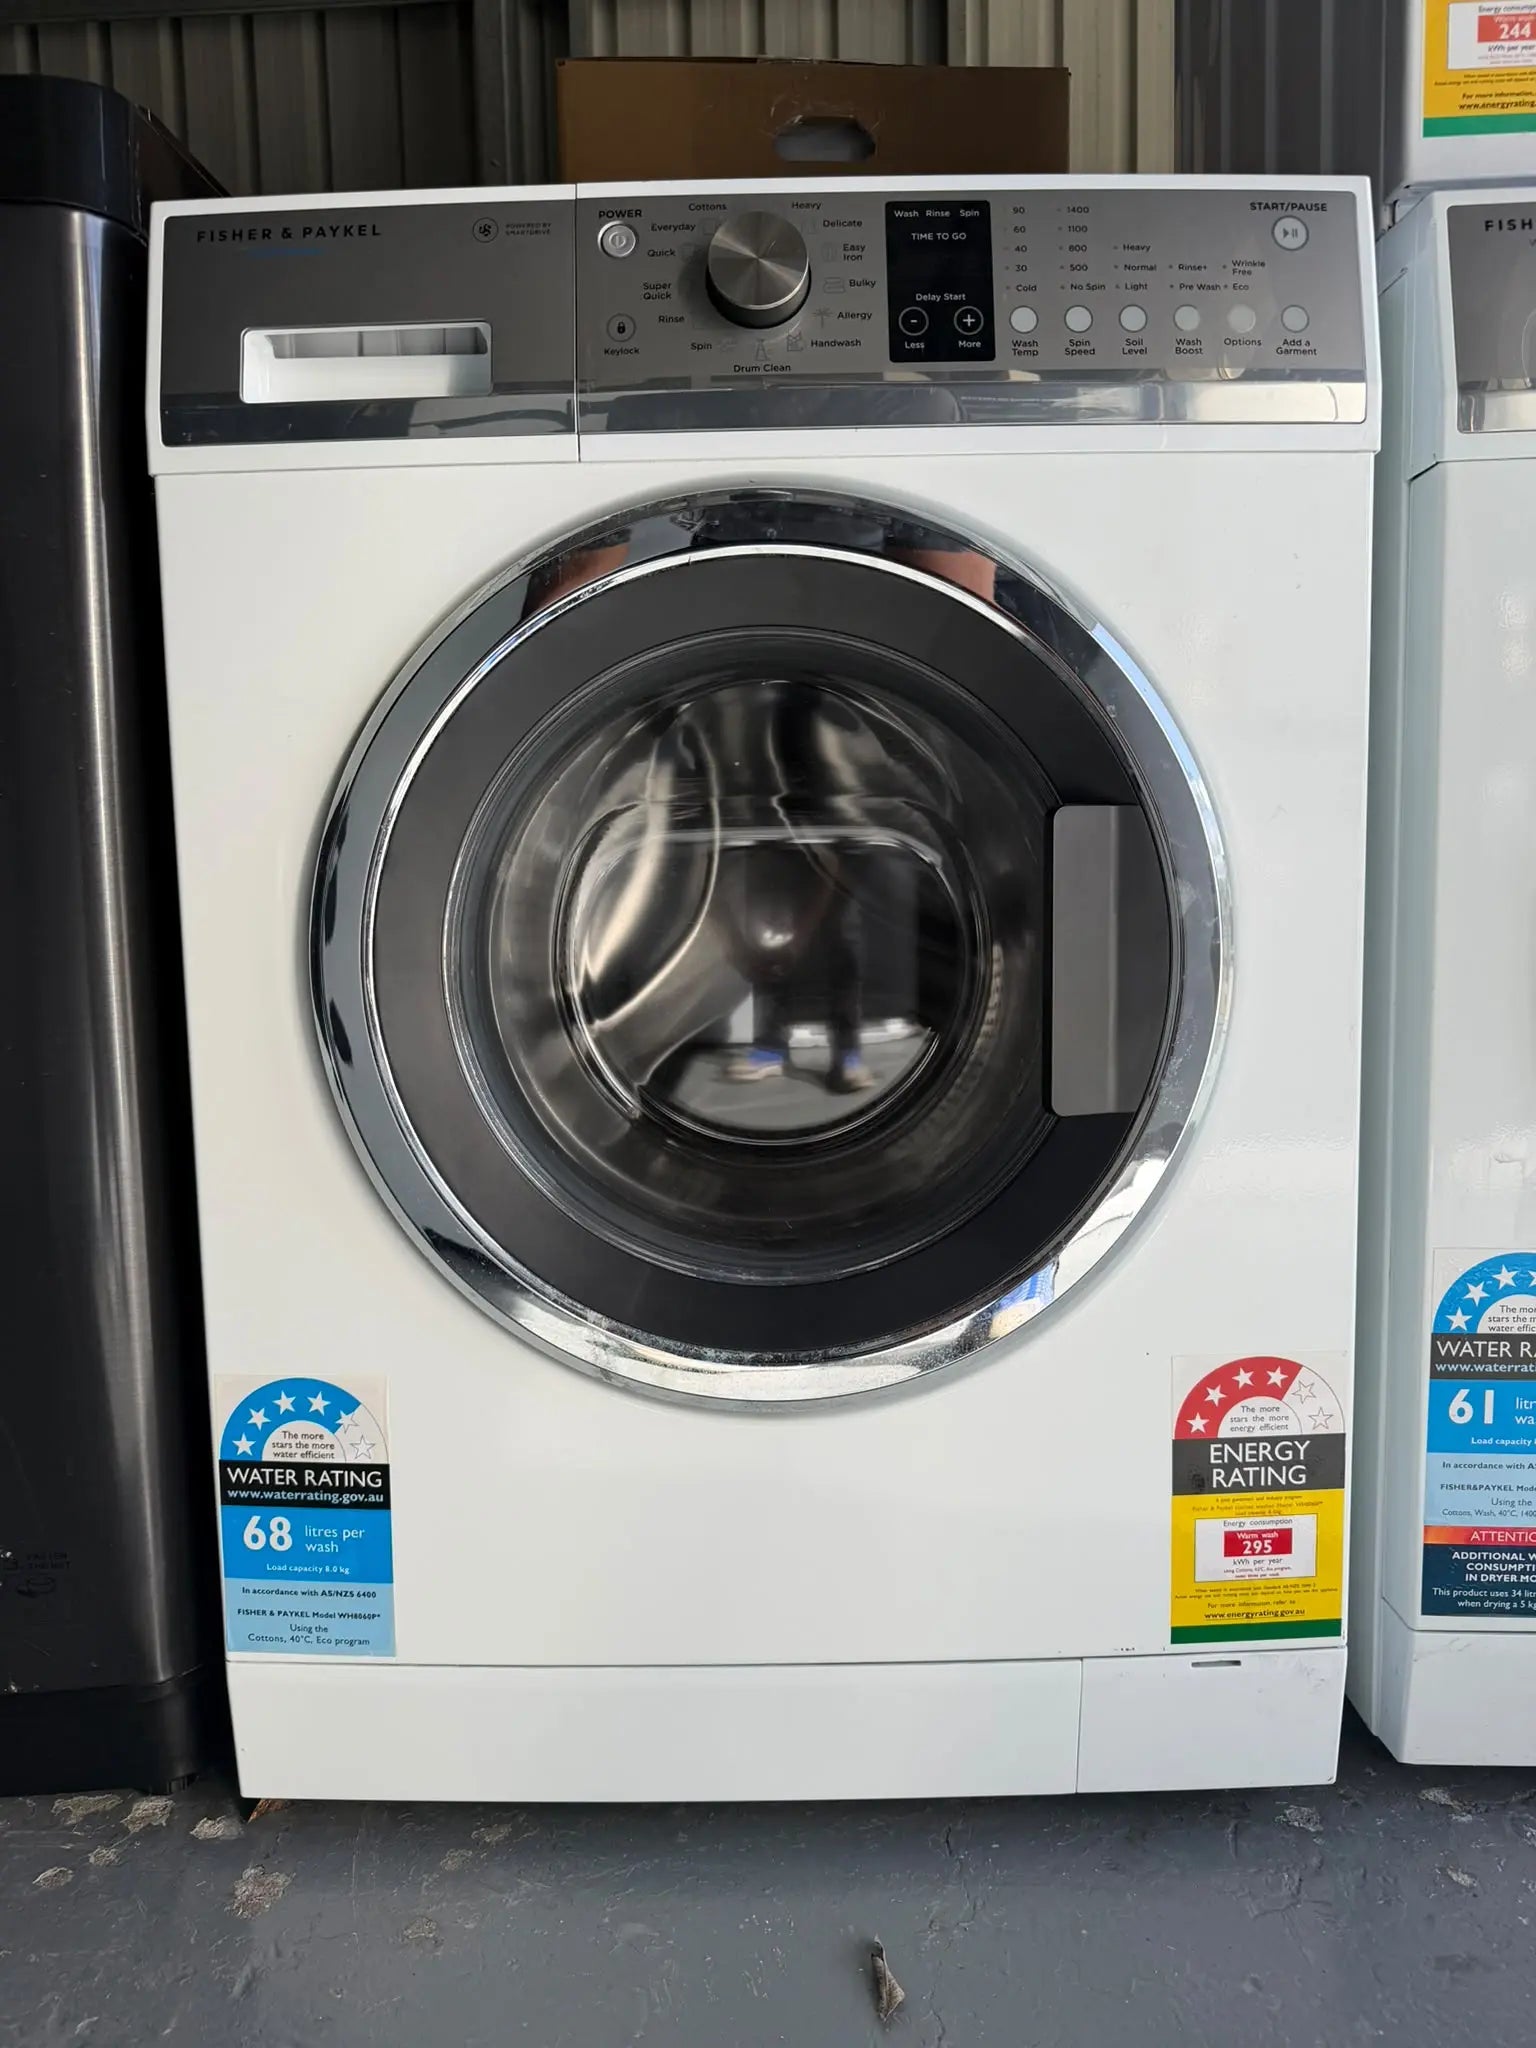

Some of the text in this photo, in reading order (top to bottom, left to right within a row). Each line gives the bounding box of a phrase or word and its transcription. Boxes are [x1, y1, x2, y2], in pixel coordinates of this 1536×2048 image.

[1500, 22, 1530, 39] 244
[688, 202, 727, 210] Cottons
[792, 202, 821, 210] Heavy
[1250, 202, 1328, 212] START/PAUSE
[598, 209, 642, 218] POWER
[894, 210, 919, 218] Wash
[960, 209, 980, 218] Spin
[651, 223, 696, 232] Everyday
[823, 220, 862, 228] Delicate
[1485, 218, 1532, 232] FISH
[198, 224, 380, 242] FISHER & PAYKEL
[937, 232, 949, 240] TO
[648, 248, 676, 257] Quick
[843, 244, 866, 252] Easy
[1123, 244, 1151, 252] Heavy
[1232, 260, 1266, 268] Wrinkle
[643, 282, 672, 292] Super
[849, 280, 876, 288] Bulky
[1016, 284, 1037, 292] Cold
[1086, 284, 1106, 292] Spin
[1125, 283, 1148, 291] Light
[643, 292, 672, 300] Quick
[916, 293, 941, 302] Delay
[838, 311, 872, 320] Allergy
[690, 342, 712, 351] Spin
[810, 339, 862, 348] Handwash
[904, 341, 925, 349] Less
[1012, 340, 1038, 348] Wash
[1069, 339, 1090, 348] Spin
[1126, 338, 1144, 346] Soil
[1176, 338, 1202, 346] Wash
[1224, 338, 1262, 346] Options
[604, 347, 640, 356] Keylock
[1012, 348, 1038, 358] Temp
[1065, 348, 1096, 356] Speed
[1176, 347, 1203, 355] Boost
[734, 364, 792, 372] Drum Clean
[1500, 1305, 1516, 1313] The
[1512, 1314, 1527, 1322] the
[1436, 1341, 1512, 1358] WATER
[1448, 1388, 1494, 1424] 61
[282, 1431, 298, 1440] The
[1496, 1438, 1532, 1446] capacity
[300, 1451, 334, 1459] efficient
[1210, 1440, 1310, 1464] ENERGY
[227, 1468, 382, 1488] WATER RATING
[1212, 1466, 1306, 1488] RATING
[228, 1490, 384, 1504] www.waterrating.gov.au
[1492, 1498, 1516, 1508] Using
[244, 1516, 364, 1552] 68 litres per
[306, 1542, 338, 1552] wash
[1242, 1540, 1272, 1554] 295
[1452, 1552, 1525, 1560] ADDITIONAL
[289, 1564, 322, 1574] capacity
[340, 1566, 350, 1574] kg
[252, 1588, 298, 1596] accordance
[1432, 1588, 1450, 1596] This
[1452, 1589, 1488, 1598] product
[1484, 1600, 1510, 1610] drying
[290, 1624, 312, 1634] Using
[248, 1634, 370, 1646] Cottons, Eco program
